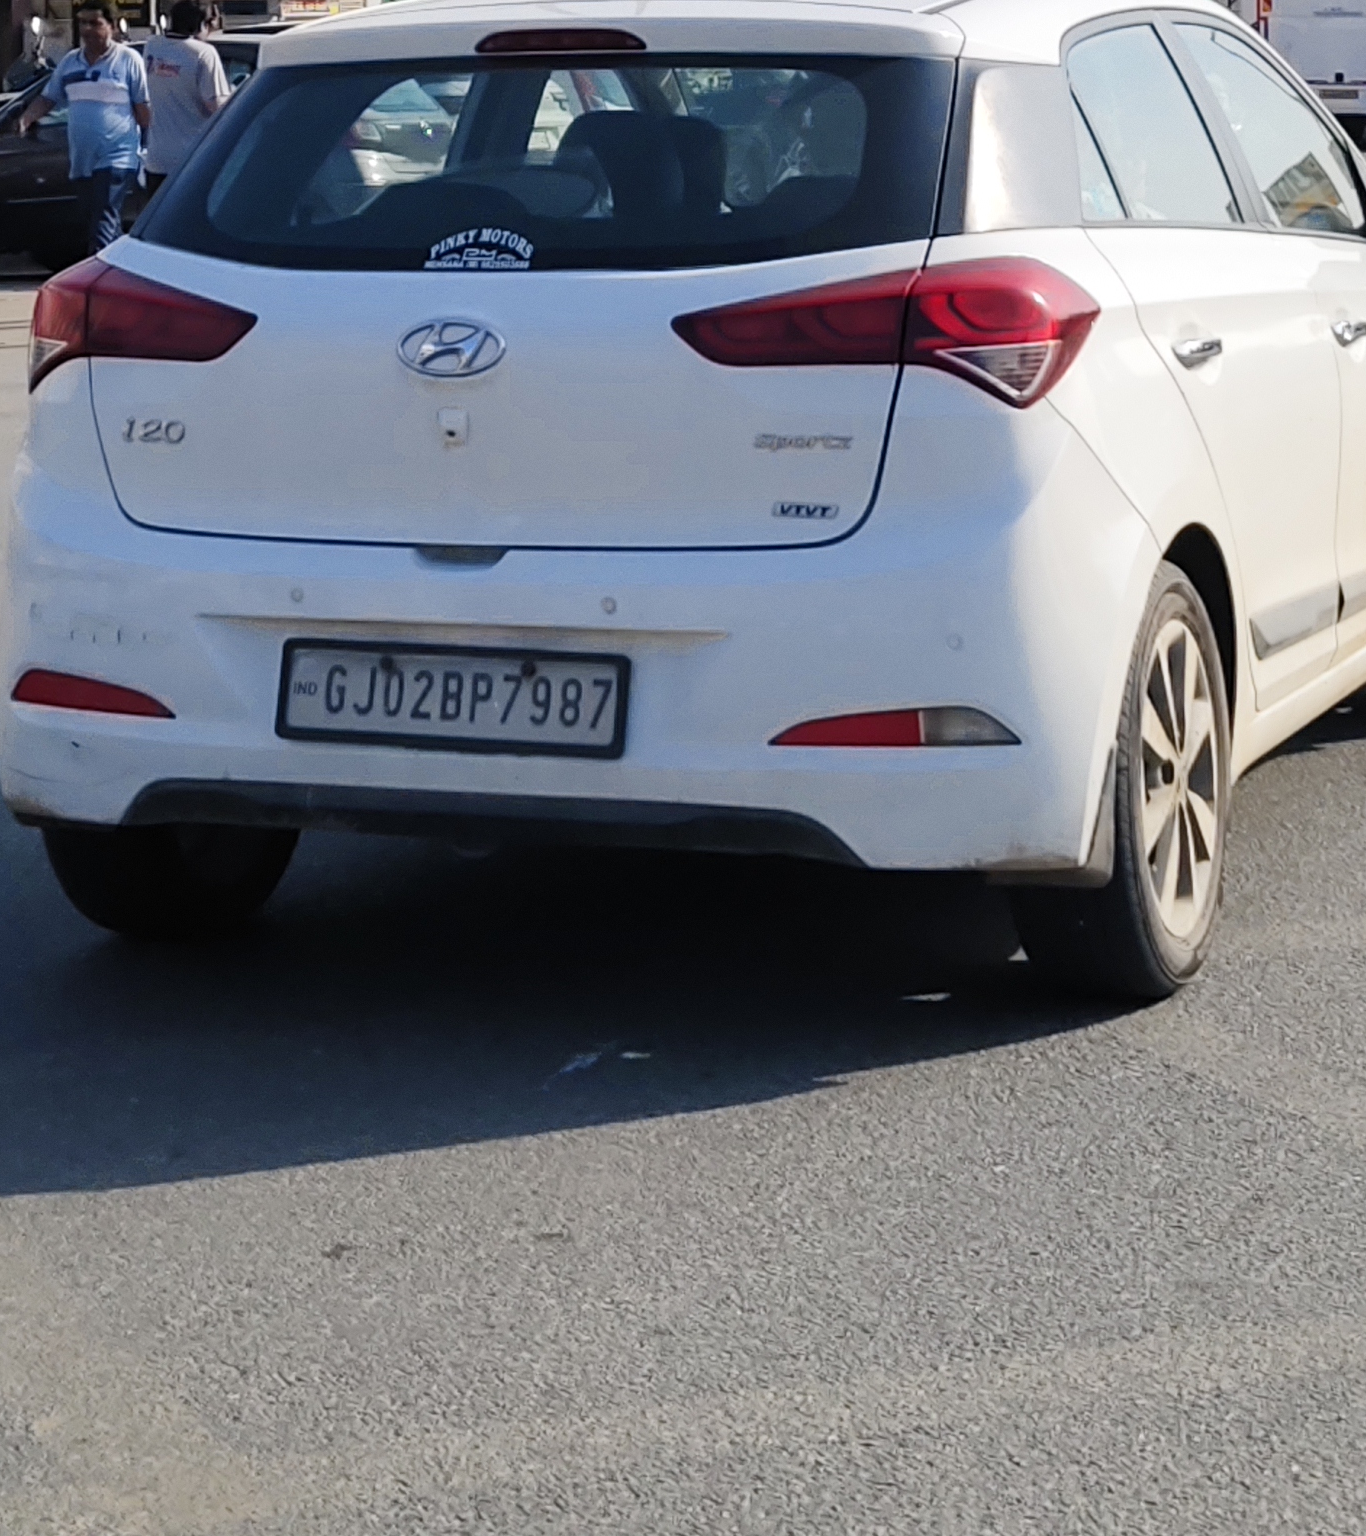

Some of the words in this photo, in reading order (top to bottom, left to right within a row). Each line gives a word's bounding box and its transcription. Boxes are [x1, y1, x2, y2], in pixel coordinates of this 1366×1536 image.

[430, 228, 478, 261] PINKY
[478, 228, 534, 259] MOTORS
[779, 503, 832, 518] VTVT
[293, 681, 318, 696] IND
[325, 664, 614, 731] GJ02BP7987
